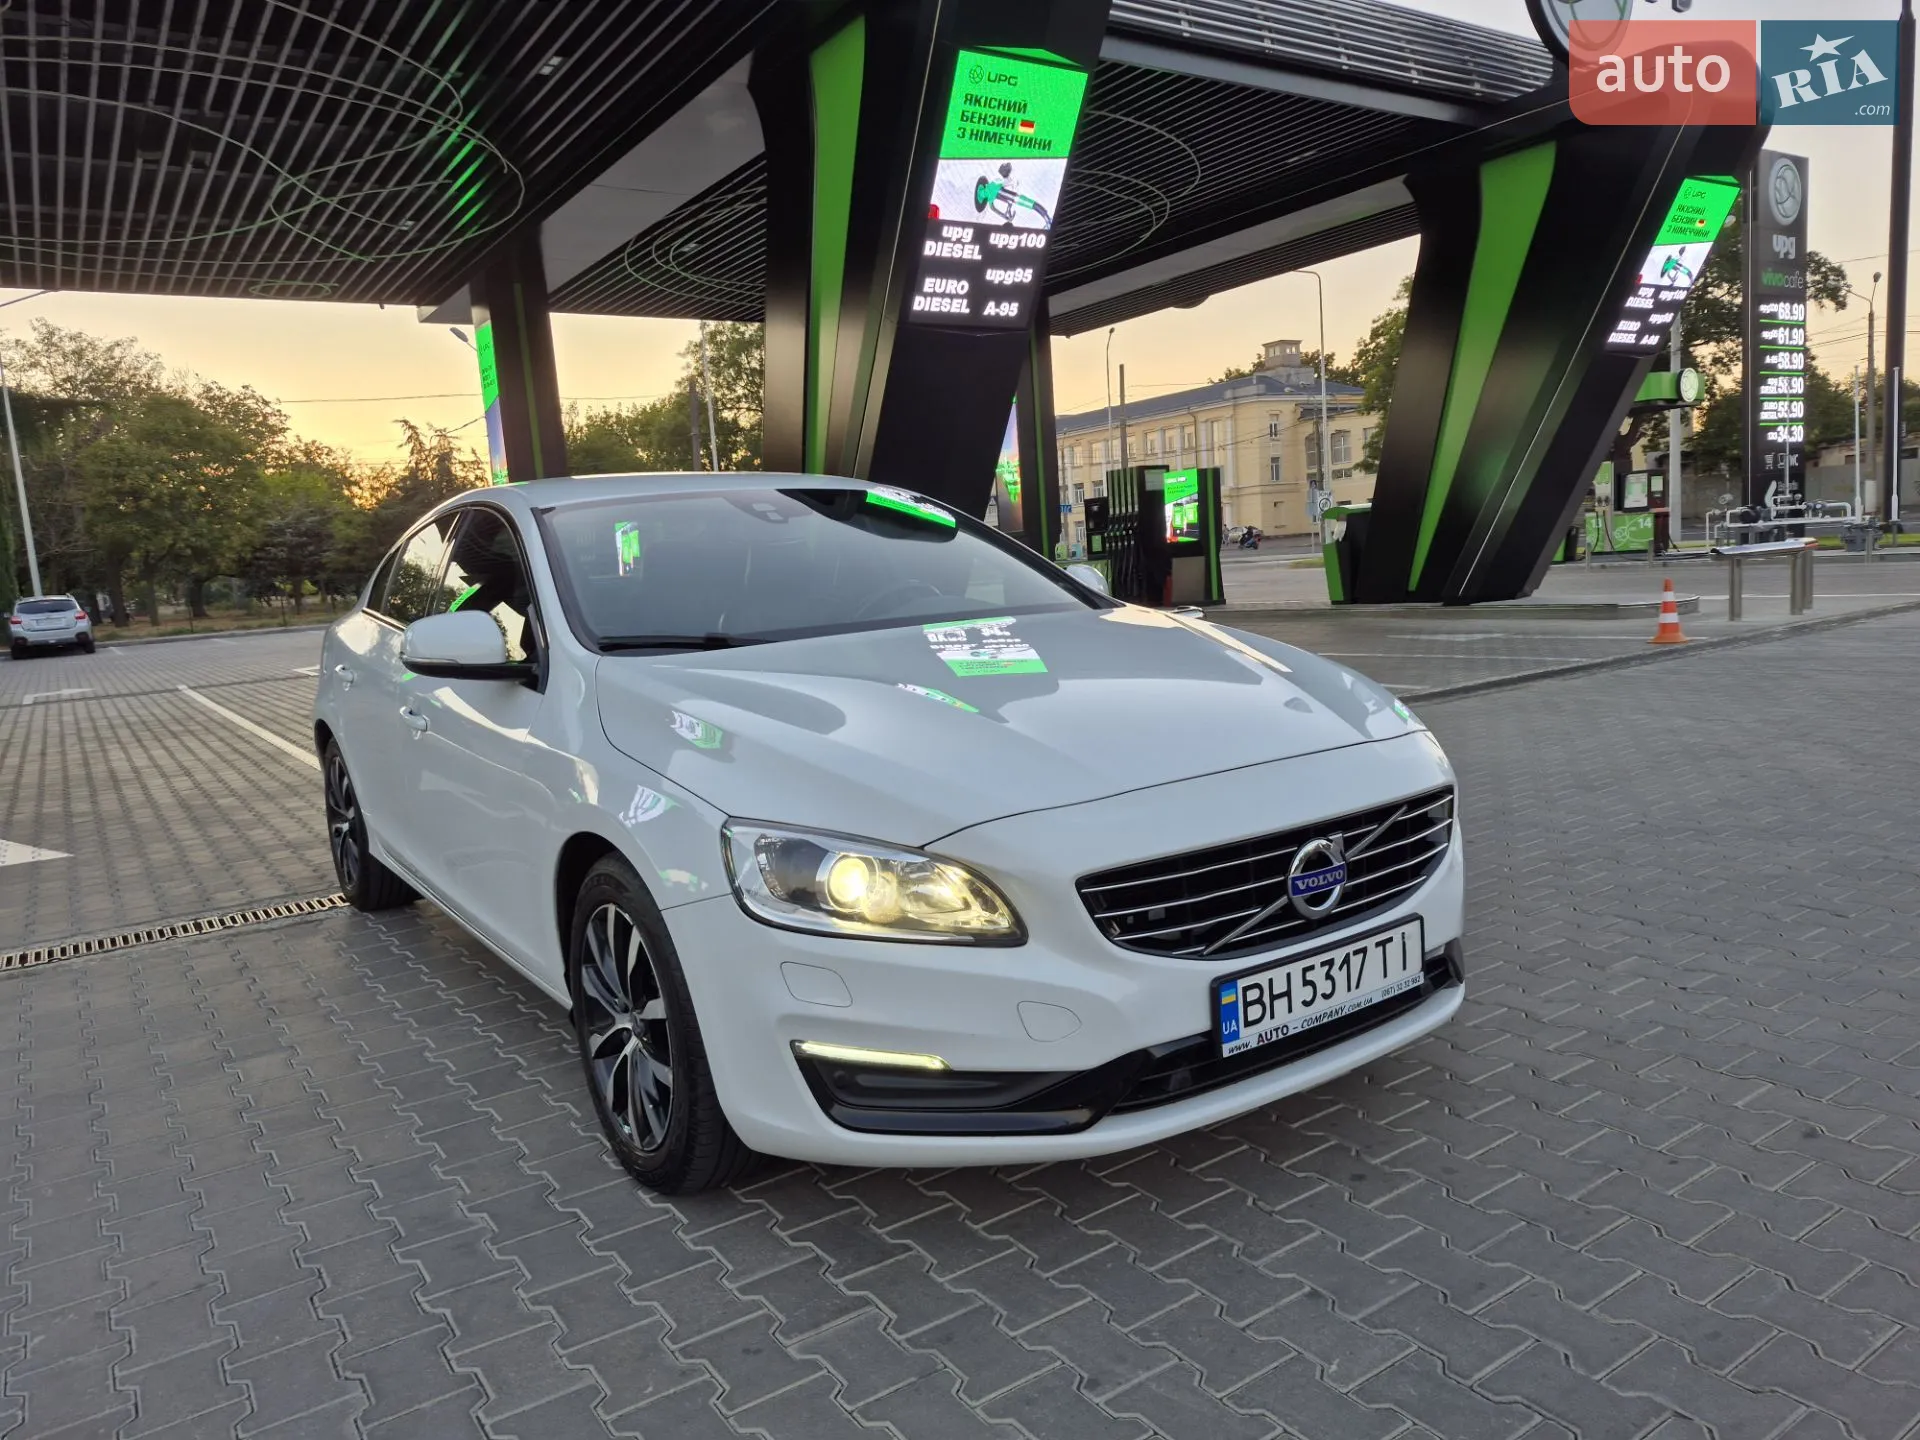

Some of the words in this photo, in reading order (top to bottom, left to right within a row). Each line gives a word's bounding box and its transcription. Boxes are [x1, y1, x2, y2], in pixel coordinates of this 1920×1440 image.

[987, 72, 1018, 87] UPG
[963, 92, 1028, 114] ЯКІСНИЙ
[959, 110, 1016, 130] БЕНЗИН
[968, 128, 1053, 152] НІМЕЧЧИНИ
[942, 225, 974, 243] upg
[989, 232, 1046, 249] upg100
[924, 240, 982, 261] DIESEL
[1772, 234, 1796, 259] upg
[923, 277, 969, 294] EURO
[985, 267, 1033, 285] upg95
[912, 296, 970, 314] DIESEL
[983, 301, 1019, 317] A-95
[1778, 301, 1805, 321] 68.90
[1778, 327, 1805, 346] 61.90
[1777, 351, 1804, 370] 58.90
[1640, 516, 1652, 529] 14
[1294, 869, 1344, 890] VOLVO
[1241, 971, 1292, 1028] BH
[1301, 945, 1368, 1008] 5317
[1222, 1019, 1239, 1035] UA
[1256, 1024, 1290, 1045] AUTO
